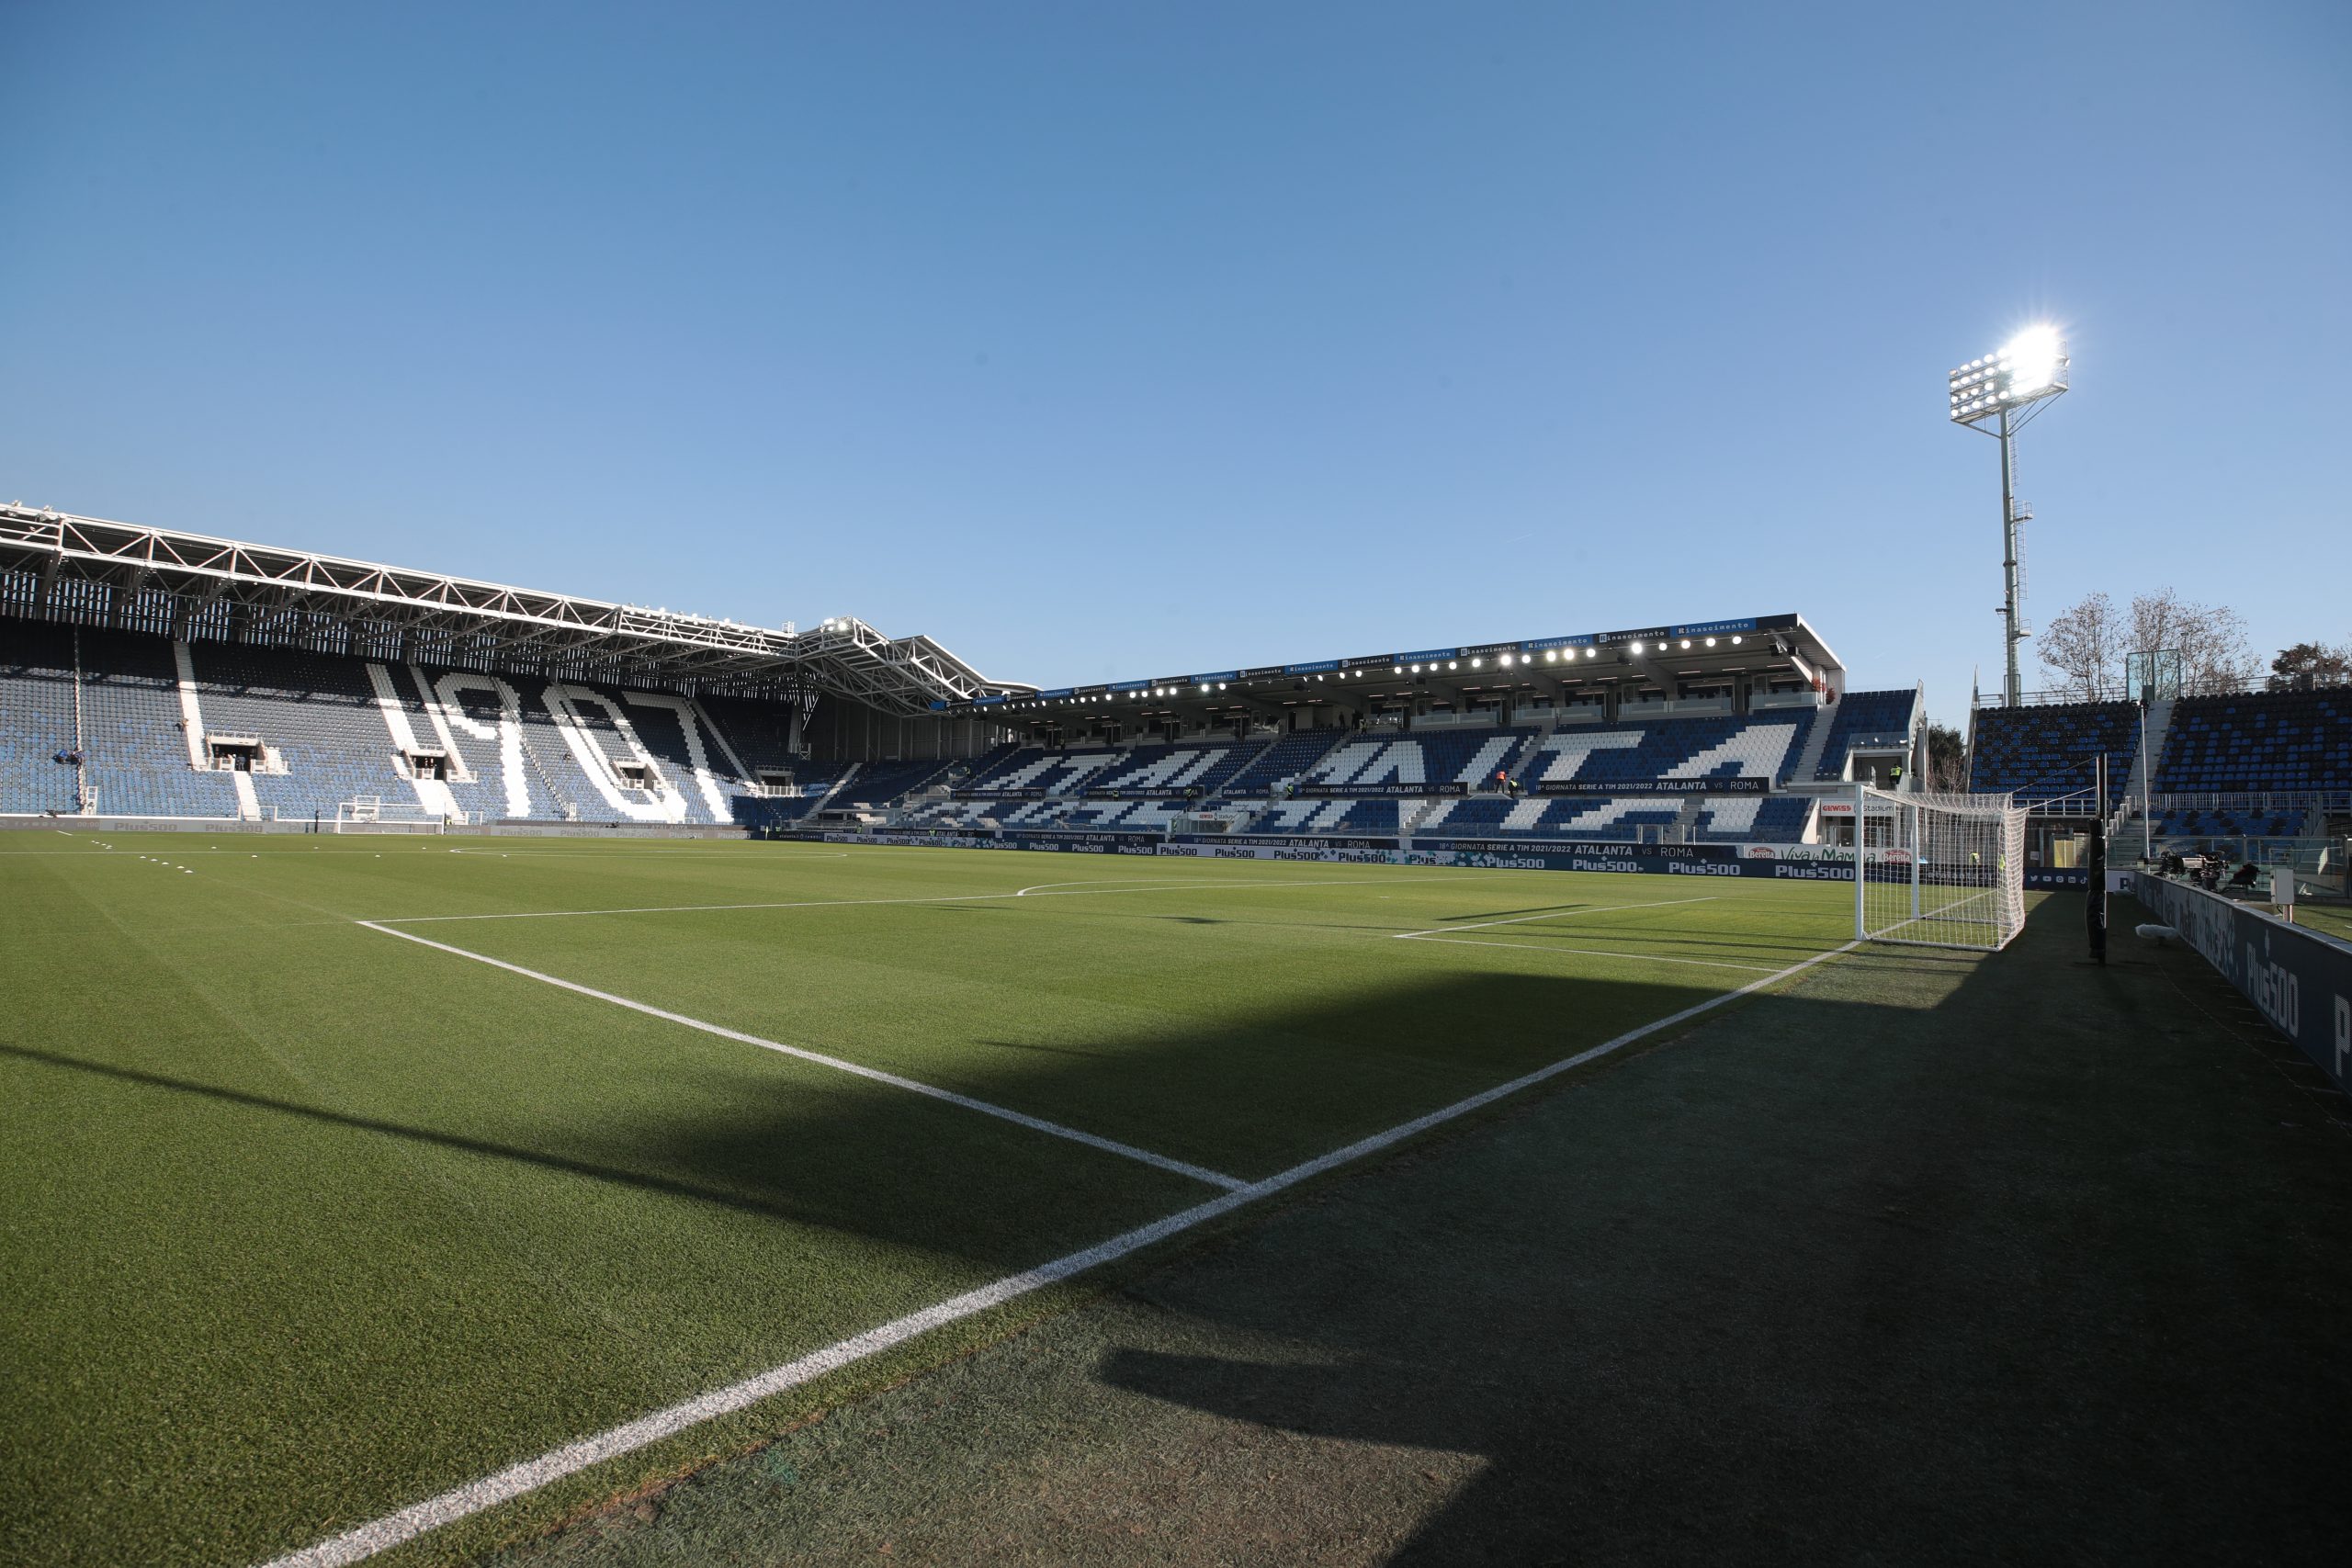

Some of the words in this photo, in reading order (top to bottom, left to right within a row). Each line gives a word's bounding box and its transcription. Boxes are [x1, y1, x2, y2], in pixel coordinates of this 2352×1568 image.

[1678, 622, 1748, 635] Rinascimento
[1600, 631, 1665, 643] Rinascimento
[1528, 637, 1588, 649] Rinascimento
[1461, 645, 1516, 656] Rinascimento
[1386, 785, 1423, 794] ATALANTA
[1656, 781, 1707, 790] ATALANTA
[1730, 781, 1759, 790] ROMA
[114, 822, 177, 831] Plus500
[205, 823, 263, 832] Plus500
[500, 829, 542, 837] Plus500
[1086, 834, 1114, 842] ATALANTA
[989, 841, 1018, 850] Plus500
[1029, 842, 1059, 851] Plus500
[1072, 843, 1103, 852] Plus500
[1118, 844, 1152, 854] Plus500
[1289, 839, 1329, 848] ATALANTA
[1347, 840, 1370, 849] ROMA
[1160, 847, 1197, 856] Plus500
[1215, 848, 1255, 858] Plus500
[1273, 850, 1317, 860] Plus500
[1487, 843, 1508, 852] SERIE
[1531, 844, 1571, 852] 2021/2022
[1574, 844, 1633, 856] ATALANTA
[1660, 847, 1694, 858] ROMA
[1781, 846, 1810, 861] Viva
[1339, 852, 1386, 863] Plus500
[1487, 857, 1545, 869] Plus500
[1572, 859, 1637, 872] Plus500
[1668, 862, 1740, 875] Plus500
[1775, 864, 1855, 879] Plus500
[2246, 941, 2299, 1038] Plus500
